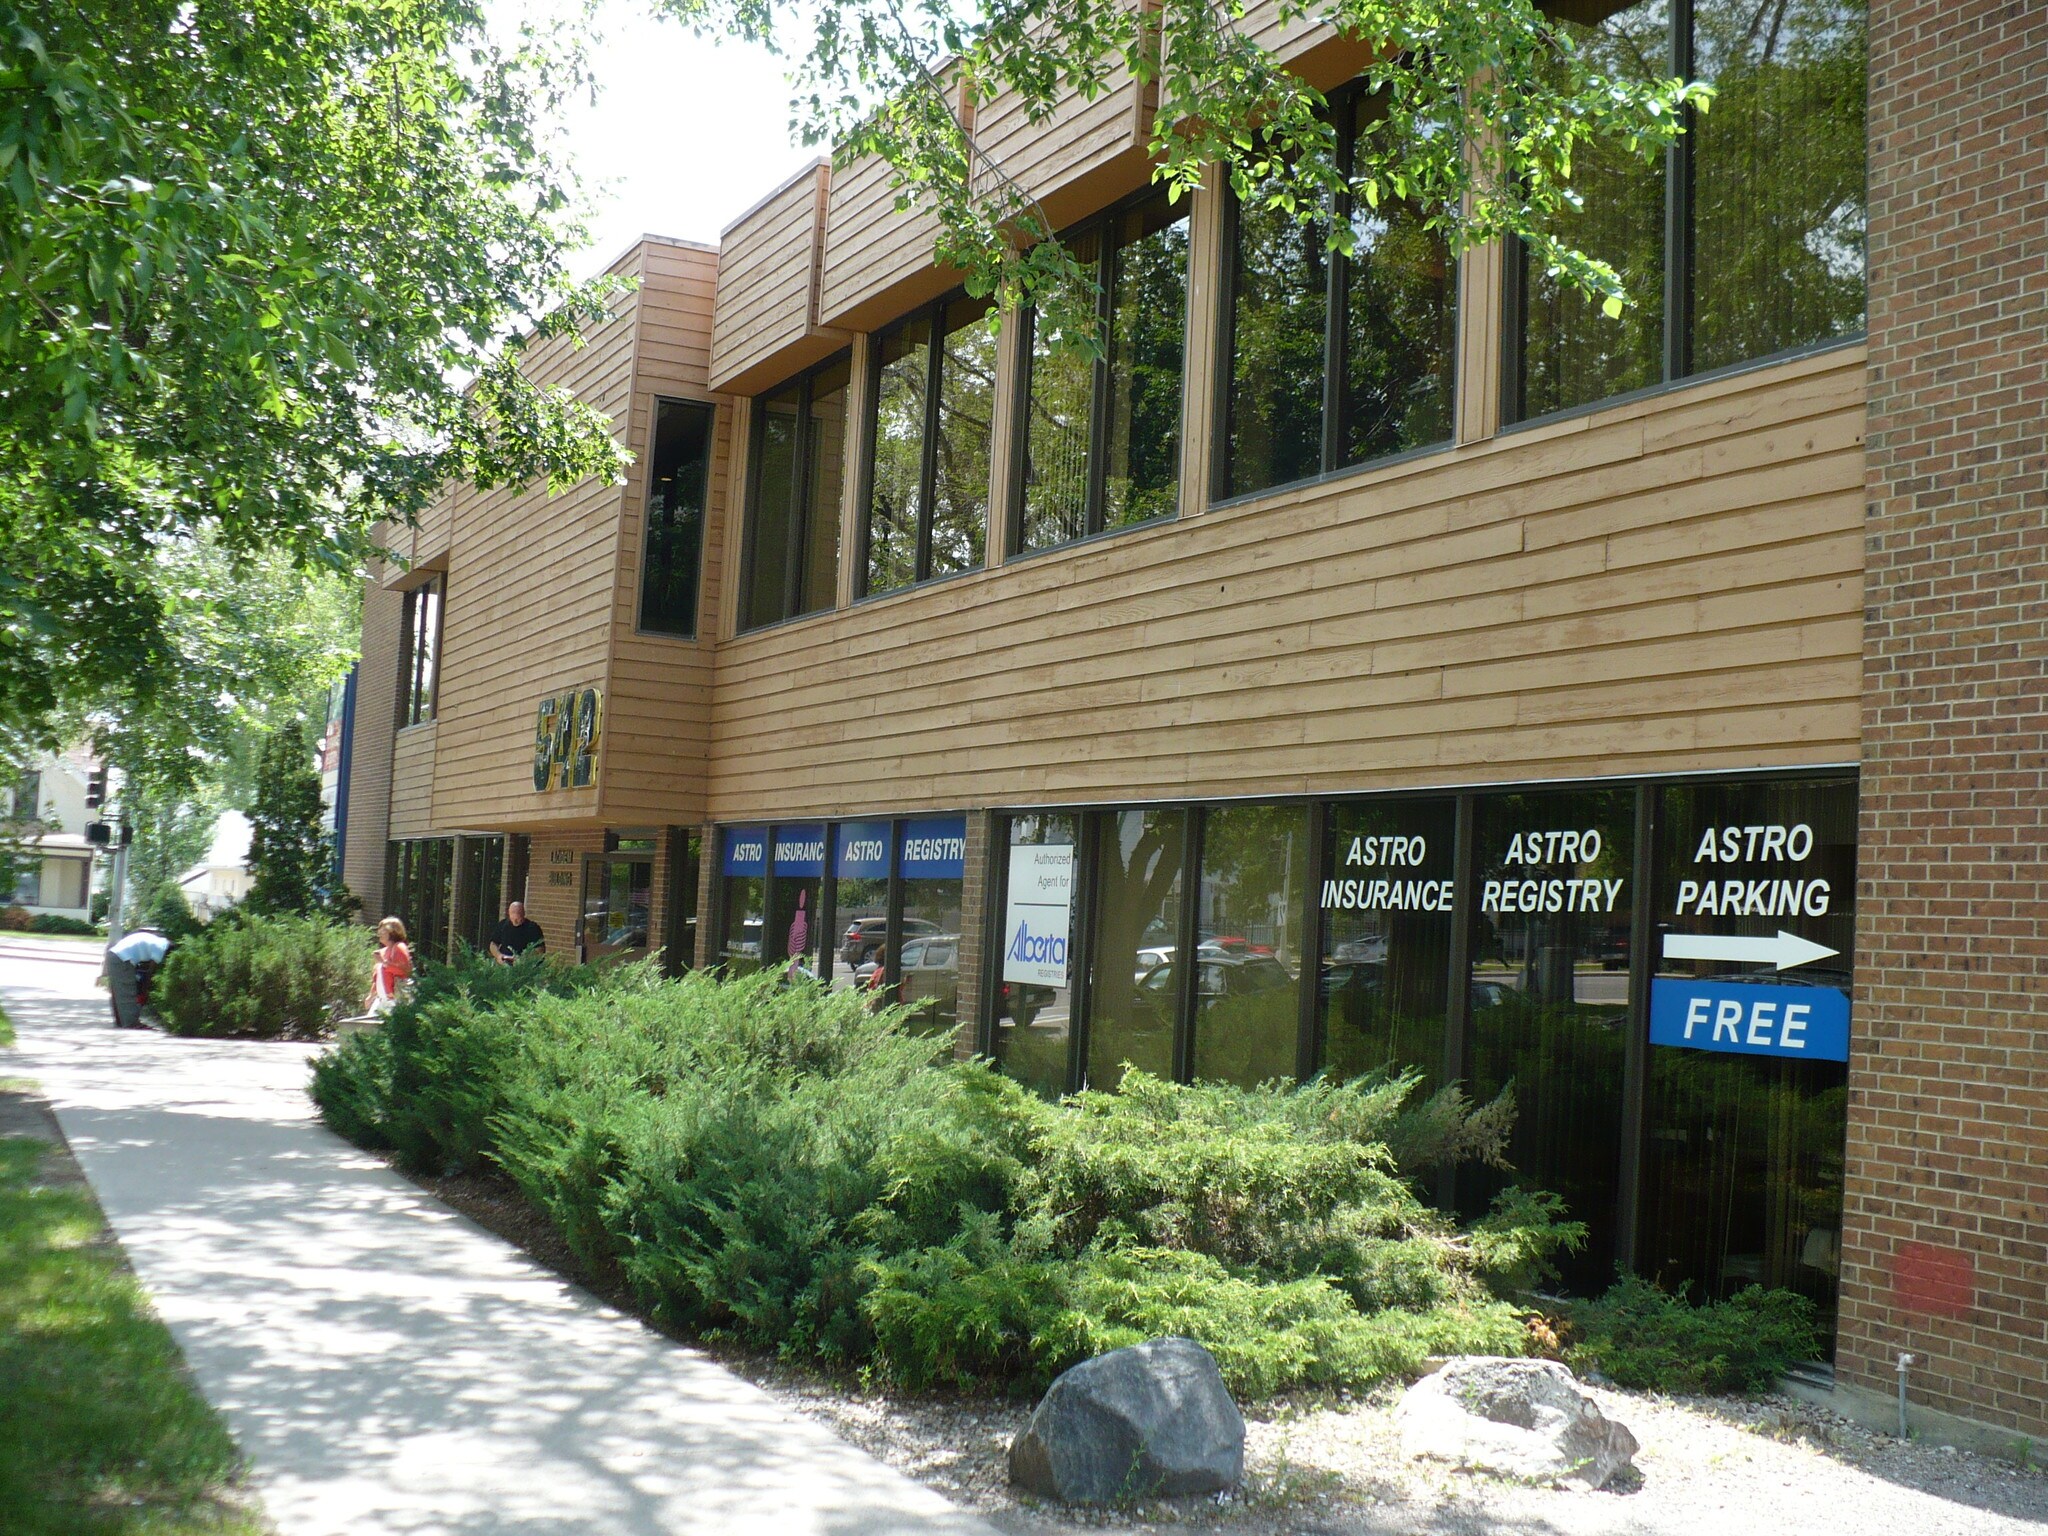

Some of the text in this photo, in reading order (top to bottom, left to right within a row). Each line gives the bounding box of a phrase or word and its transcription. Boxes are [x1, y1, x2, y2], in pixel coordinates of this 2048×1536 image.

[533, 688, 602, 792] 542
[732, 841, 825, 862] ASTRO INSURANC
[845, 838, 966, 862] ASTRO REGISTRY
[1034, 853, 1071, 865] Authorized
[1346, 836, 1426, 866] ASTRO
[1505, 829, 1602, 866] ASTRO
[1694, 823, 1813, 863] ASTRO
[1037, 875, 1070, 890] Agent for
[1320, 879, 1454, 911] INSURANCE
[1481, 878, 1624, 913] REGISTRY
[1675, 878, 1831, 917] PARKING
[1006, 919, 1066, 965] Alberta
[1683, 998, 1811, 1049] FREE
